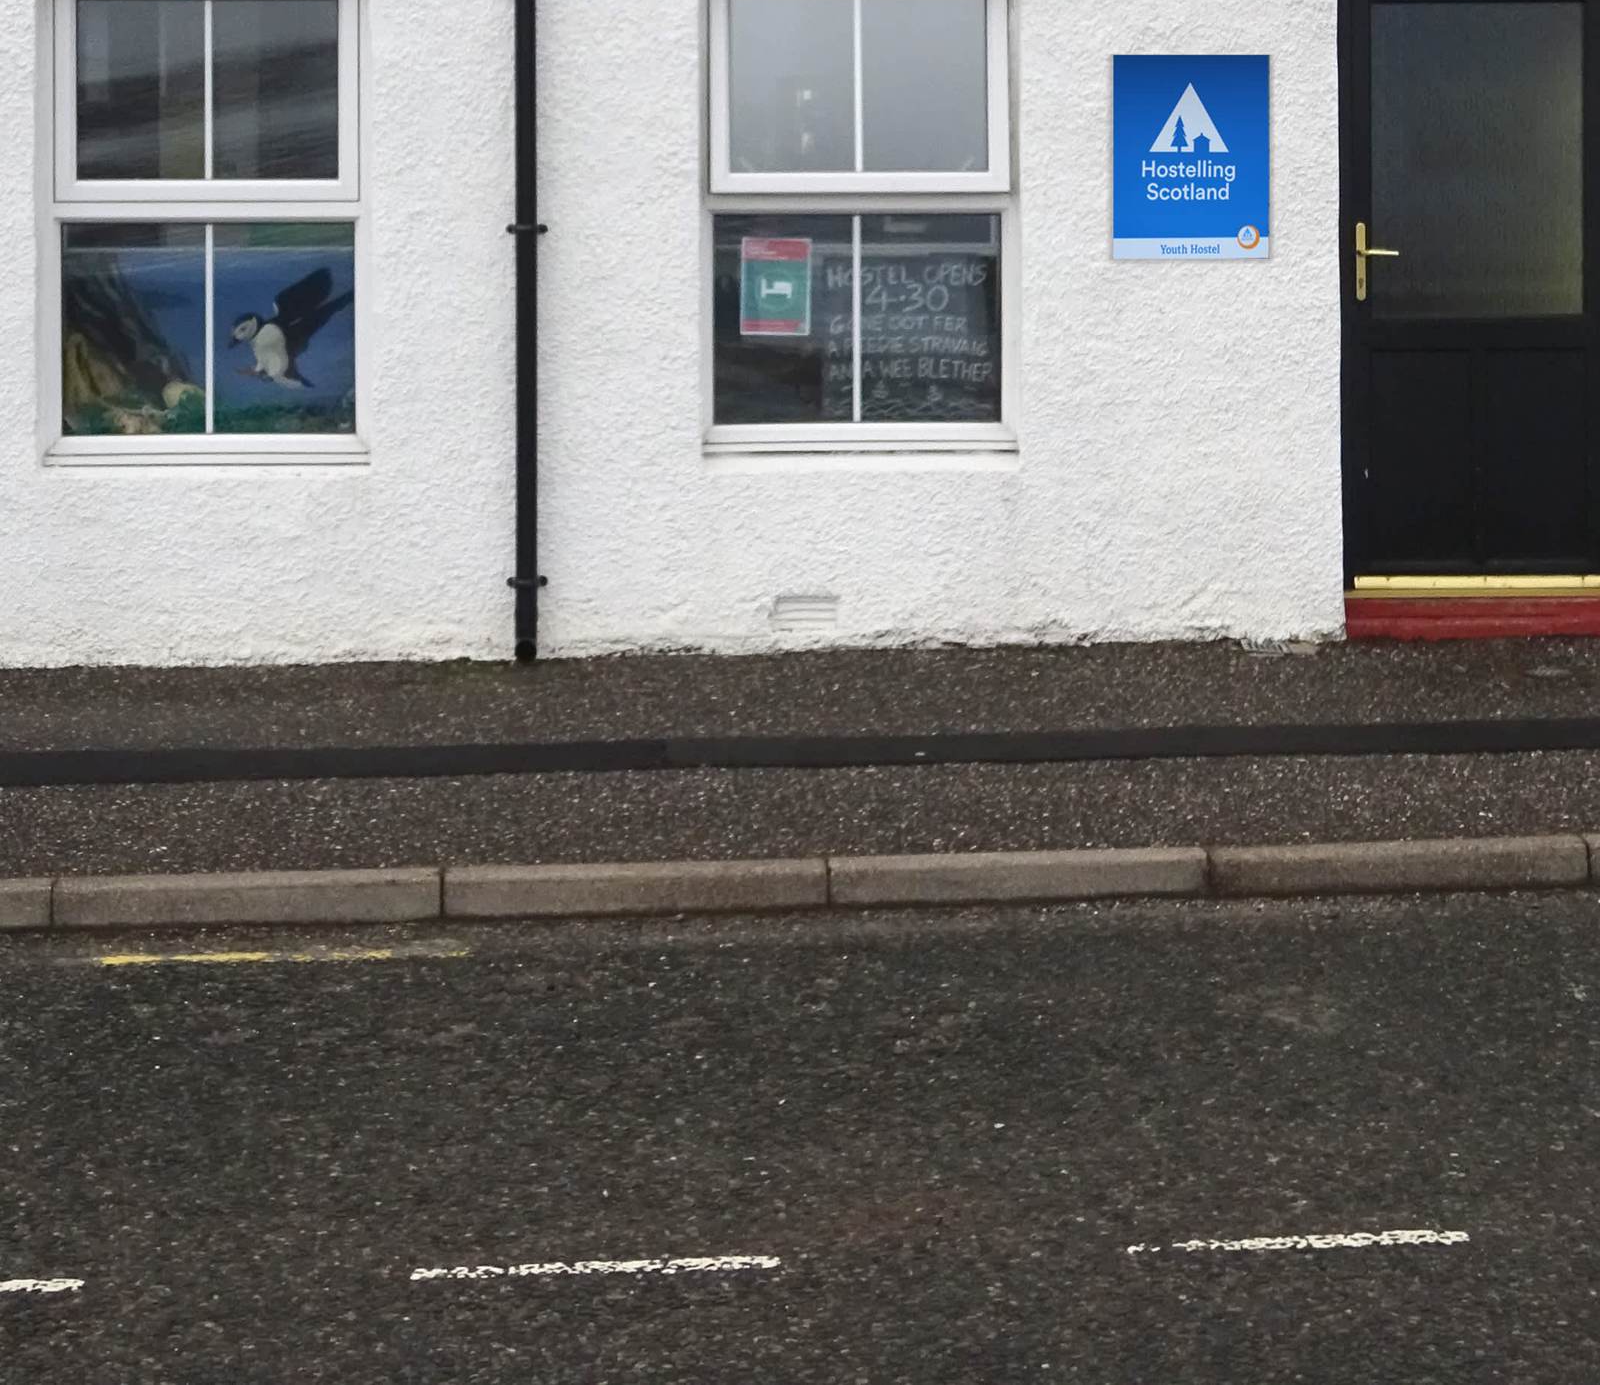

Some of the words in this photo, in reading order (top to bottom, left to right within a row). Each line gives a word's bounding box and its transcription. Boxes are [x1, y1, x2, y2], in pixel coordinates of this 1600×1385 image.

[1141, 160, 1236, 182] Hostelling
[1146, 182, 1230, 201] Scotland
[1160, 244, 1188, 255] Youth
[1190, 243, 1221, 255] Hostel
[826, 264, 915, 289] HOSTEL
[924, 262, 988, 287] OPENS
[829, 313, 886, 334] GNE
[827, 340, 839, 358] A
[879, 358, 913, 378] WEE
